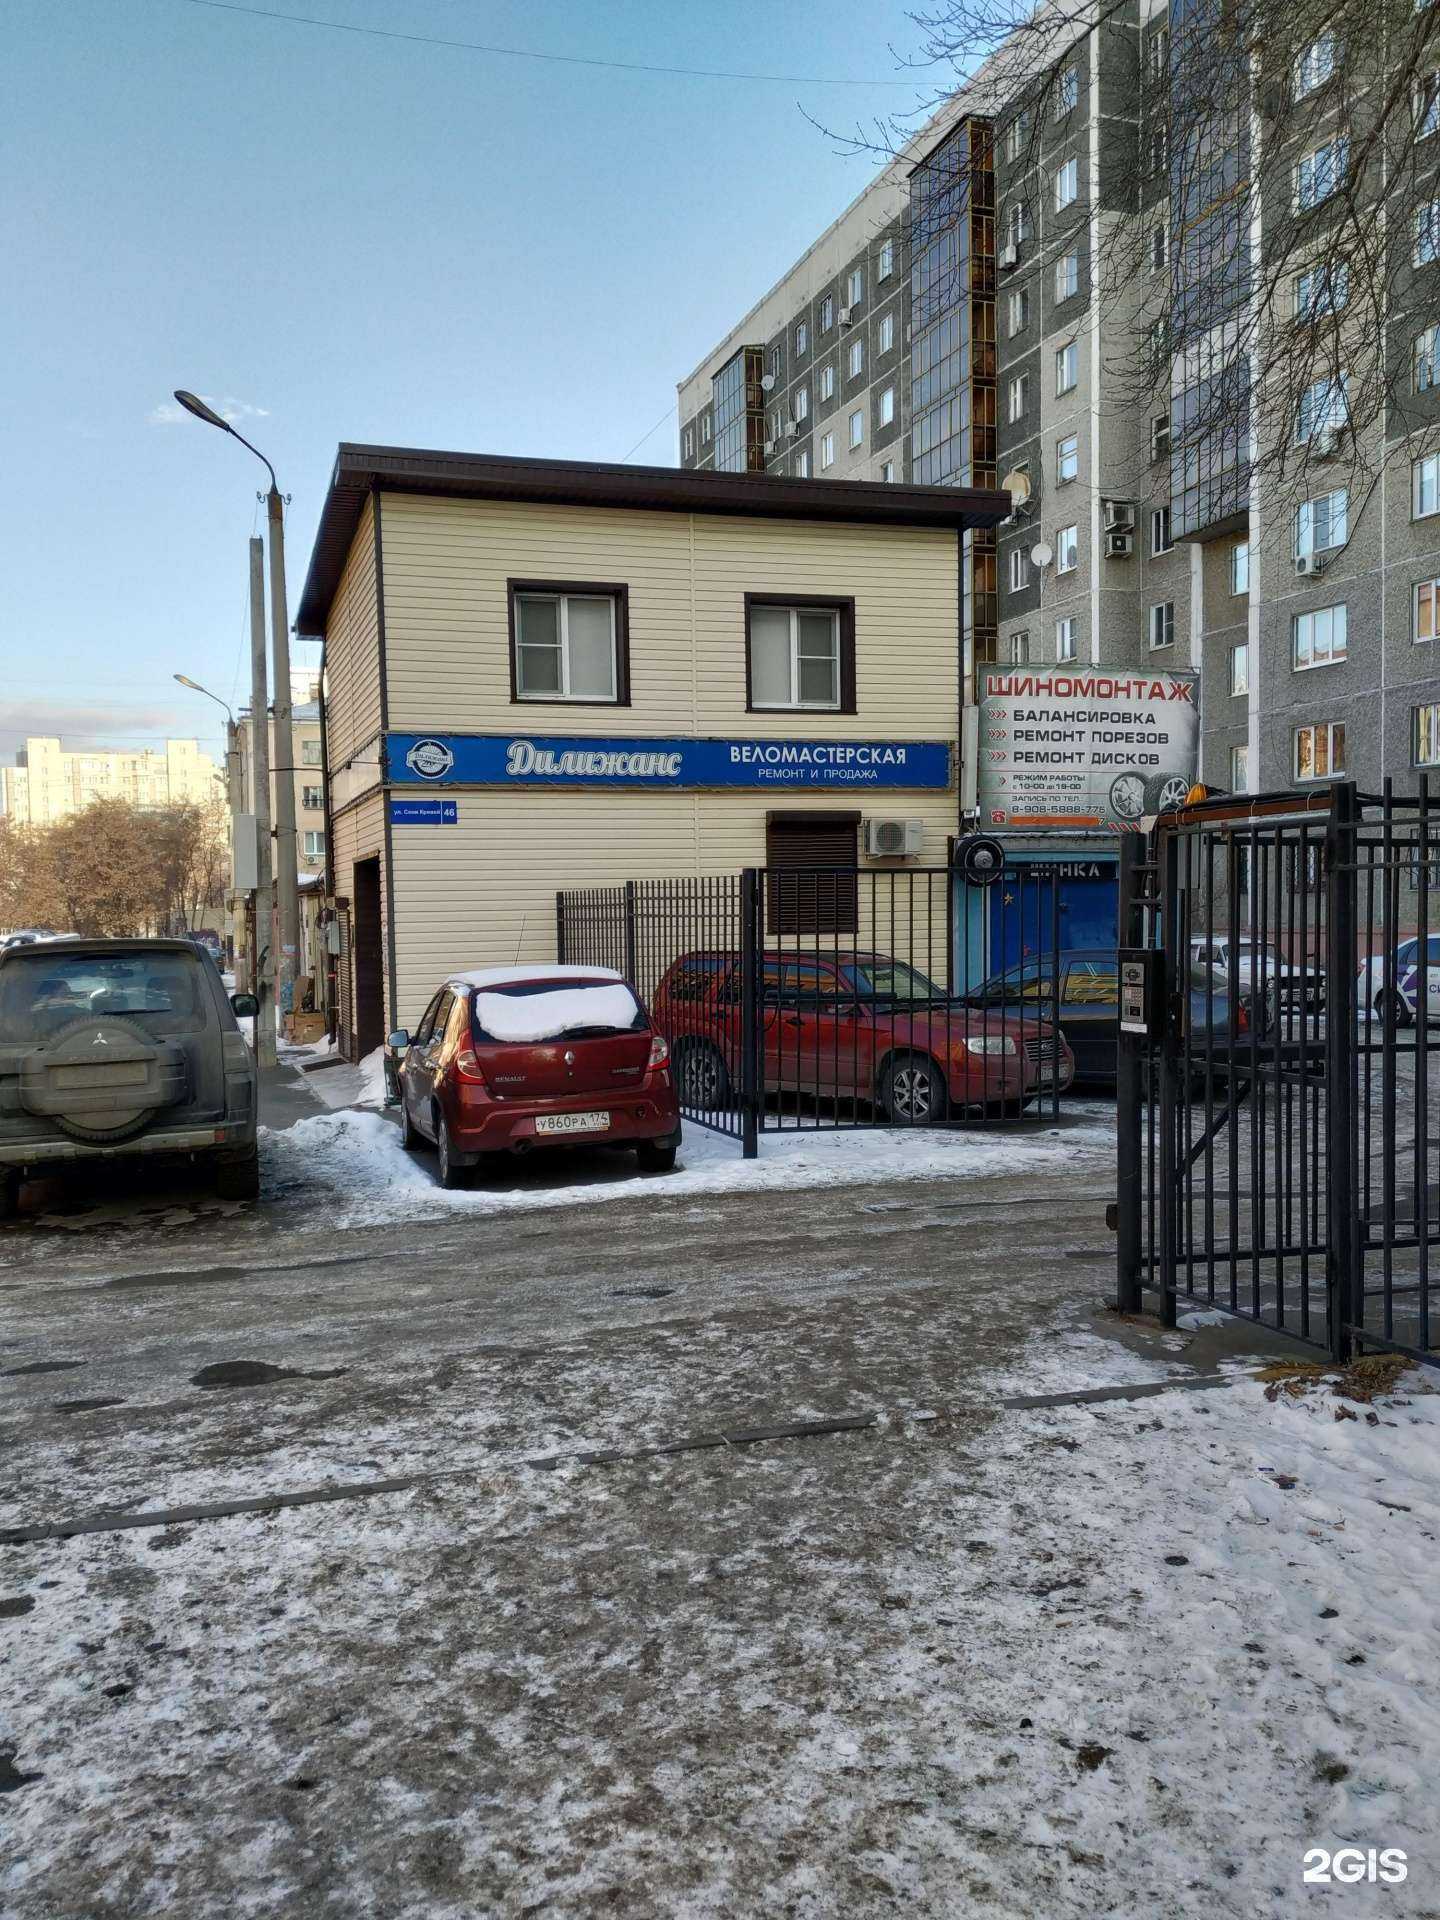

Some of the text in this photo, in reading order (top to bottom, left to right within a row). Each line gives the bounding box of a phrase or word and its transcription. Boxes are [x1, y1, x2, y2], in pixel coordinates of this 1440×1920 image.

[987, 676, 1193, 703] ШИНОМОНТАЖ
[1013, 710, 1156, 724] БАЛАНСИРОВКА
[1013, 730, 1169, 744] РЕМОНТ ПОРЕЗОВ
[505, 740, 682, 777] Дилижанс
[730, 746, 906, 764] ВЕЛОМАСТЕРСКАЯ
[1013, 751, 1160, 766] РЕМОНТ ДИСКОВ
[758, 768, 878, 780] РЕМОНТ И ПРОДАЖА
[443, 808, 455, 817] 46
